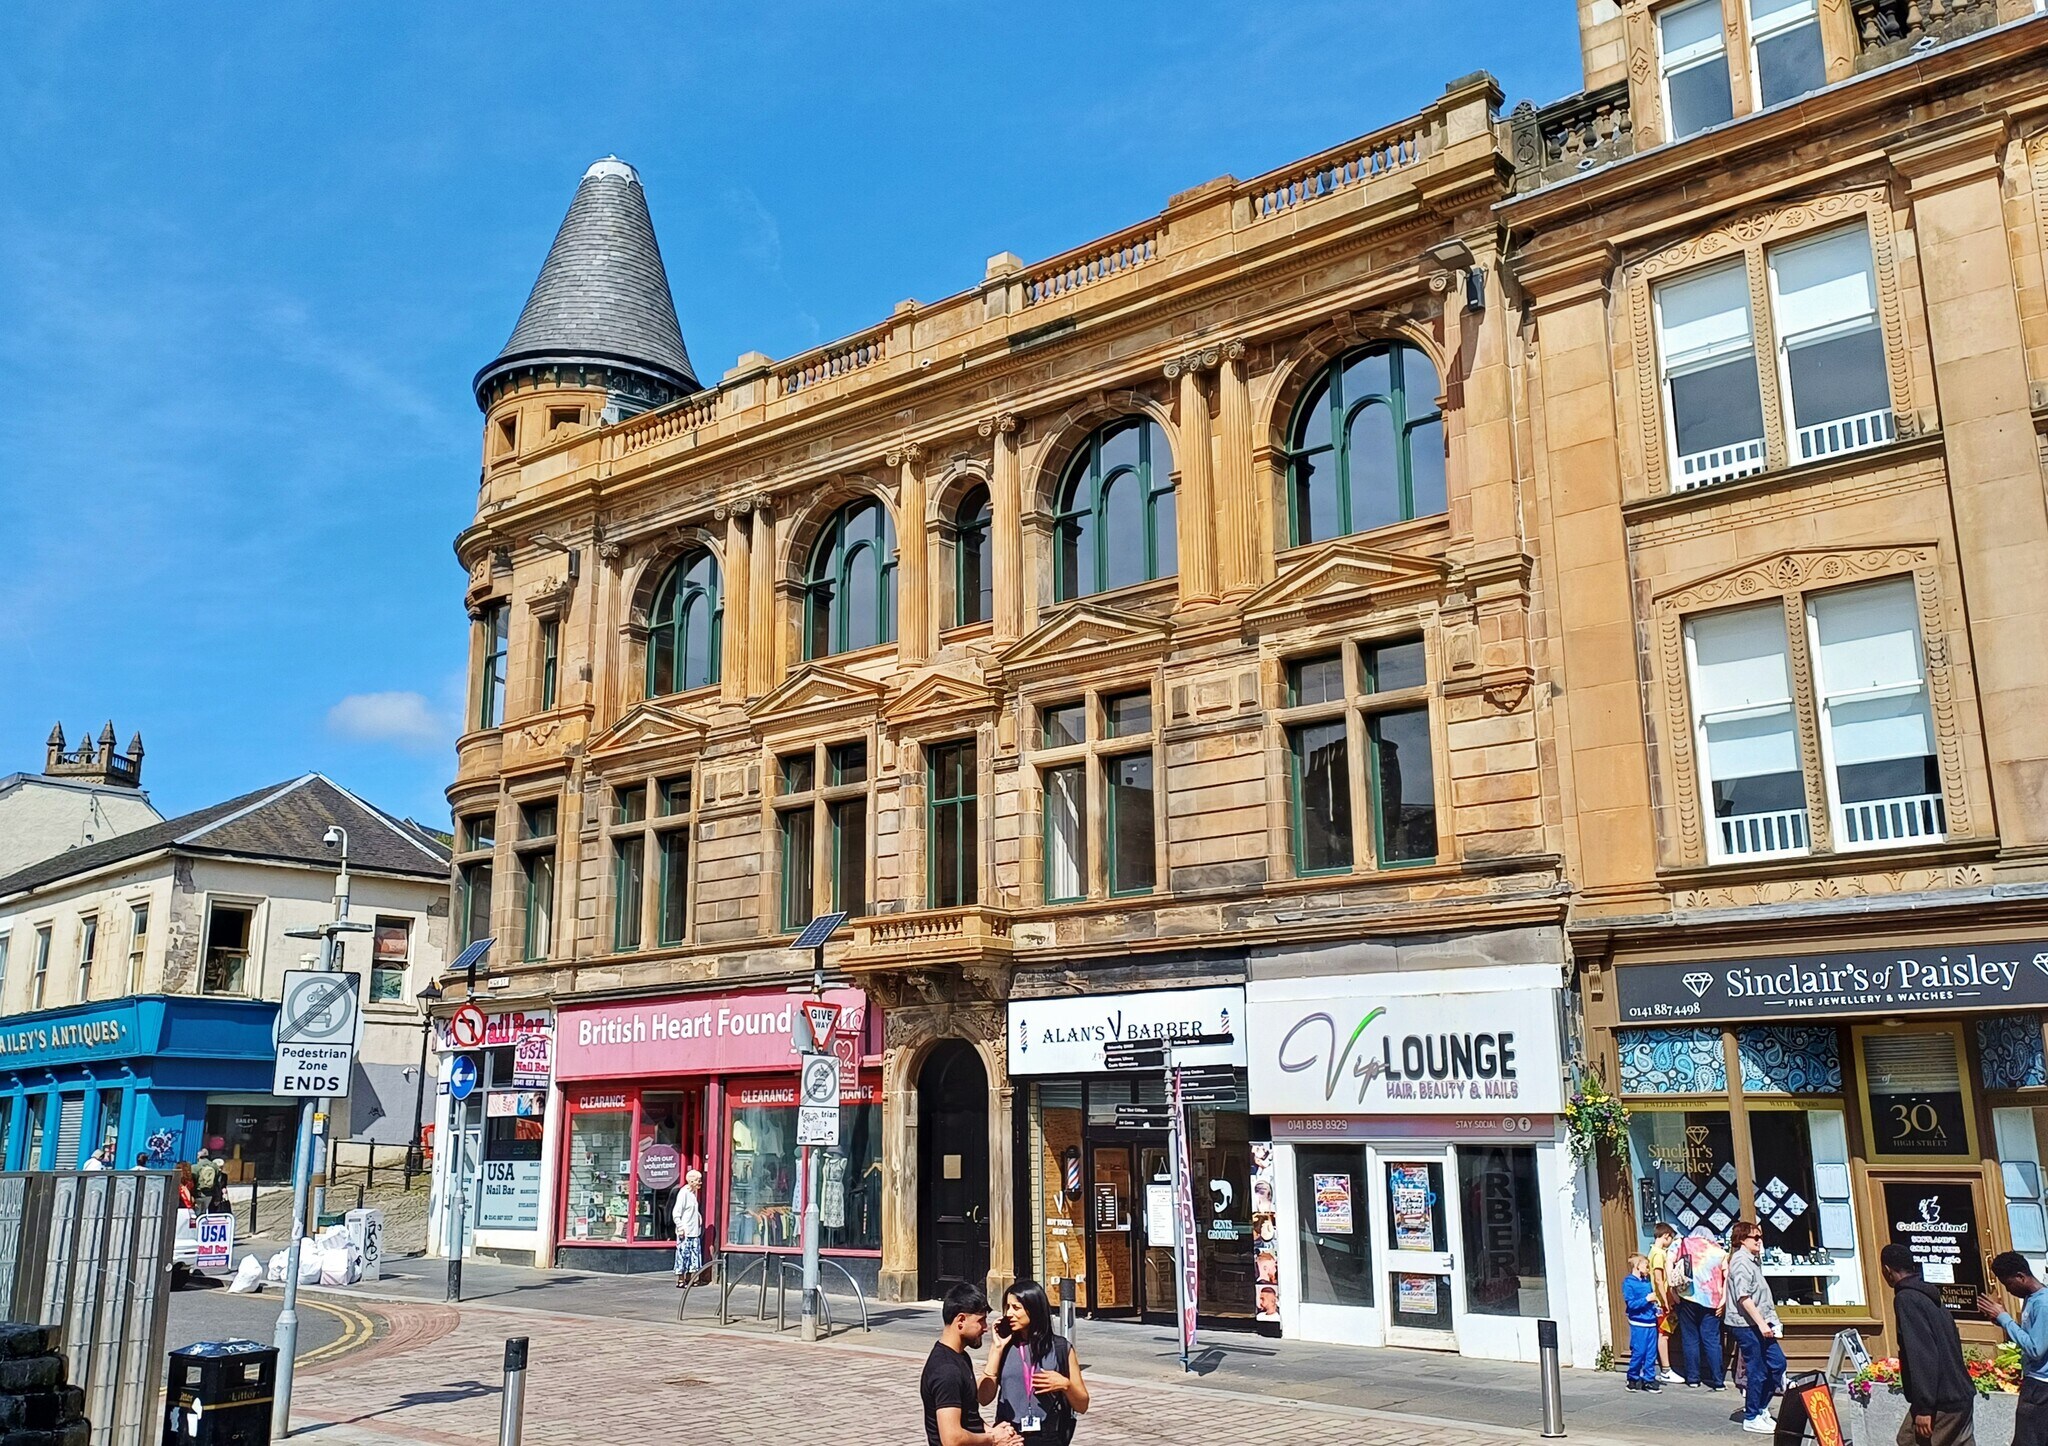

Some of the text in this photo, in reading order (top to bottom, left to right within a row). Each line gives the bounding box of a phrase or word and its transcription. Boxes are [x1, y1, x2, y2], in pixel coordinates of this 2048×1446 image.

[1726, 954, 2020, 997] Sinclair's of Paisley
[1788, 991, 1954, 1007] FINE JEWELLERY & WATCHES
[810, 1008, 833, 1021] GIVE
[1629, 1002, 1701, 1018] 0141 887 4498
[578, 1002, 858, 1046] British Heart Foundn
[815, 1021, 830, 1029] WAY
[0, 1019, 119, 1053] AILEY'S ANTIQUES
[1042, 1020, 1203, 1044] ALAN'S BARBER
[282, 1047, 347, 1058] Pedestrian
[519, 1040, 547, 1059] USA
[1383, 1032, 1517, 1081] LOUNGE
[298, 1060, 328, 1070] Zone
[515, 1061, 550, 1072] Nail Bar
[283, 1076, 340, 1091] ENDS
[1386, 1081, 1519, 1100] HAIR, BEAUTY & NAILS
[741, 1088, 794, 1103] CLEARANCE
[839, 1085, 874, 1100] RANCE
[579, 1095, 626, 1109] CLEARANCE
[1287, 1120, 1348, 1131] 0141 889 8929
[1455, 1120, 1497, 1129] STAY SOCIAL
[1916, 1139, 1948, 1147] STREET
[1647, 1143, 1714, 1159] Sinclair's
[643, 1162, 677, 1170] volunteer
[645, 1155, 661, 1163] Join
[1652, 1157, 1714, 1176] of Paisley
[487, 1163, 515, 1181] USA
[650, 1169, 669, 1177] team
[486, 1185, 515, 1195] Nail Bar
[1484, 1147, 1517, 1278] ARBER
[201, 1224, 227, 1243] USA
[1896, 1221, 1968, 1233] GoldScotland
[1942, 1286, 1974, 1296] Sinclair
